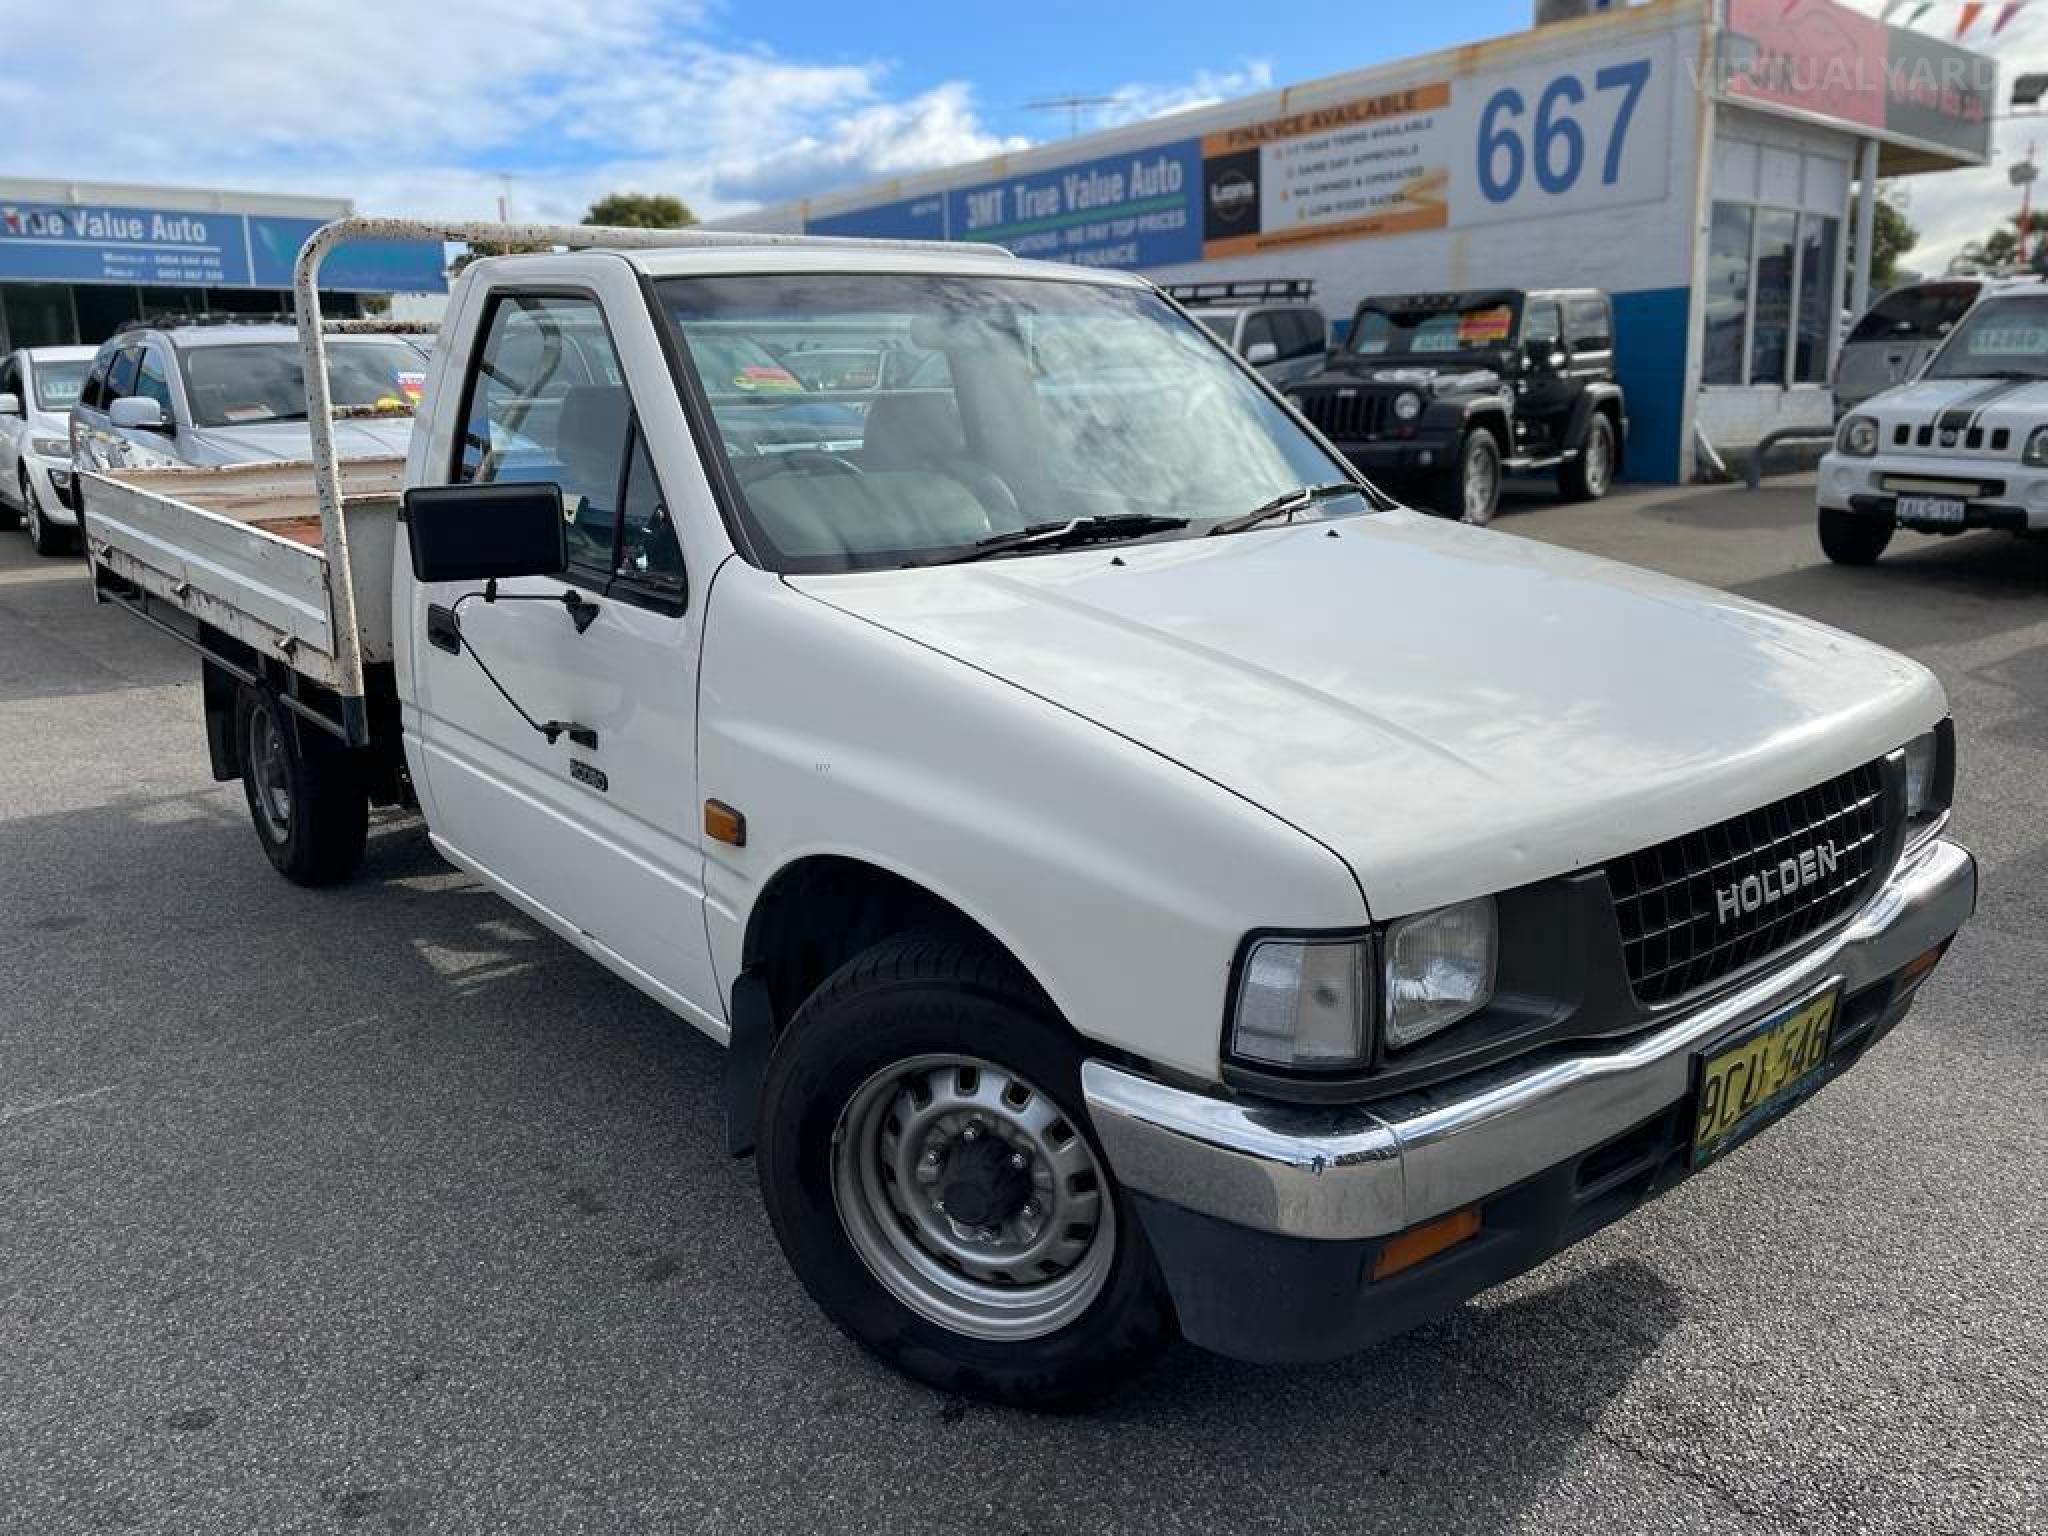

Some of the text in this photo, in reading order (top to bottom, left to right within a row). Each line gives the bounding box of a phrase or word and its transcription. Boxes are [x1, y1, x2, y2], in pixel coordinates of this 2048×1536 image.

[1227, 89, 1418, 145] FINANCE AVAILABLE
[1477, 59, 1651, 203] 667
[1012, 182, 1059, 222] True
[1064, 170, 1124, 211] Value
[1130, 155, 1183, 200] Auto
[2, 207, 208, 242] True Value Auto
[1136, 208, 1187, 231] PRICES
[1716, 839, 1837, 925] HOLDEN
